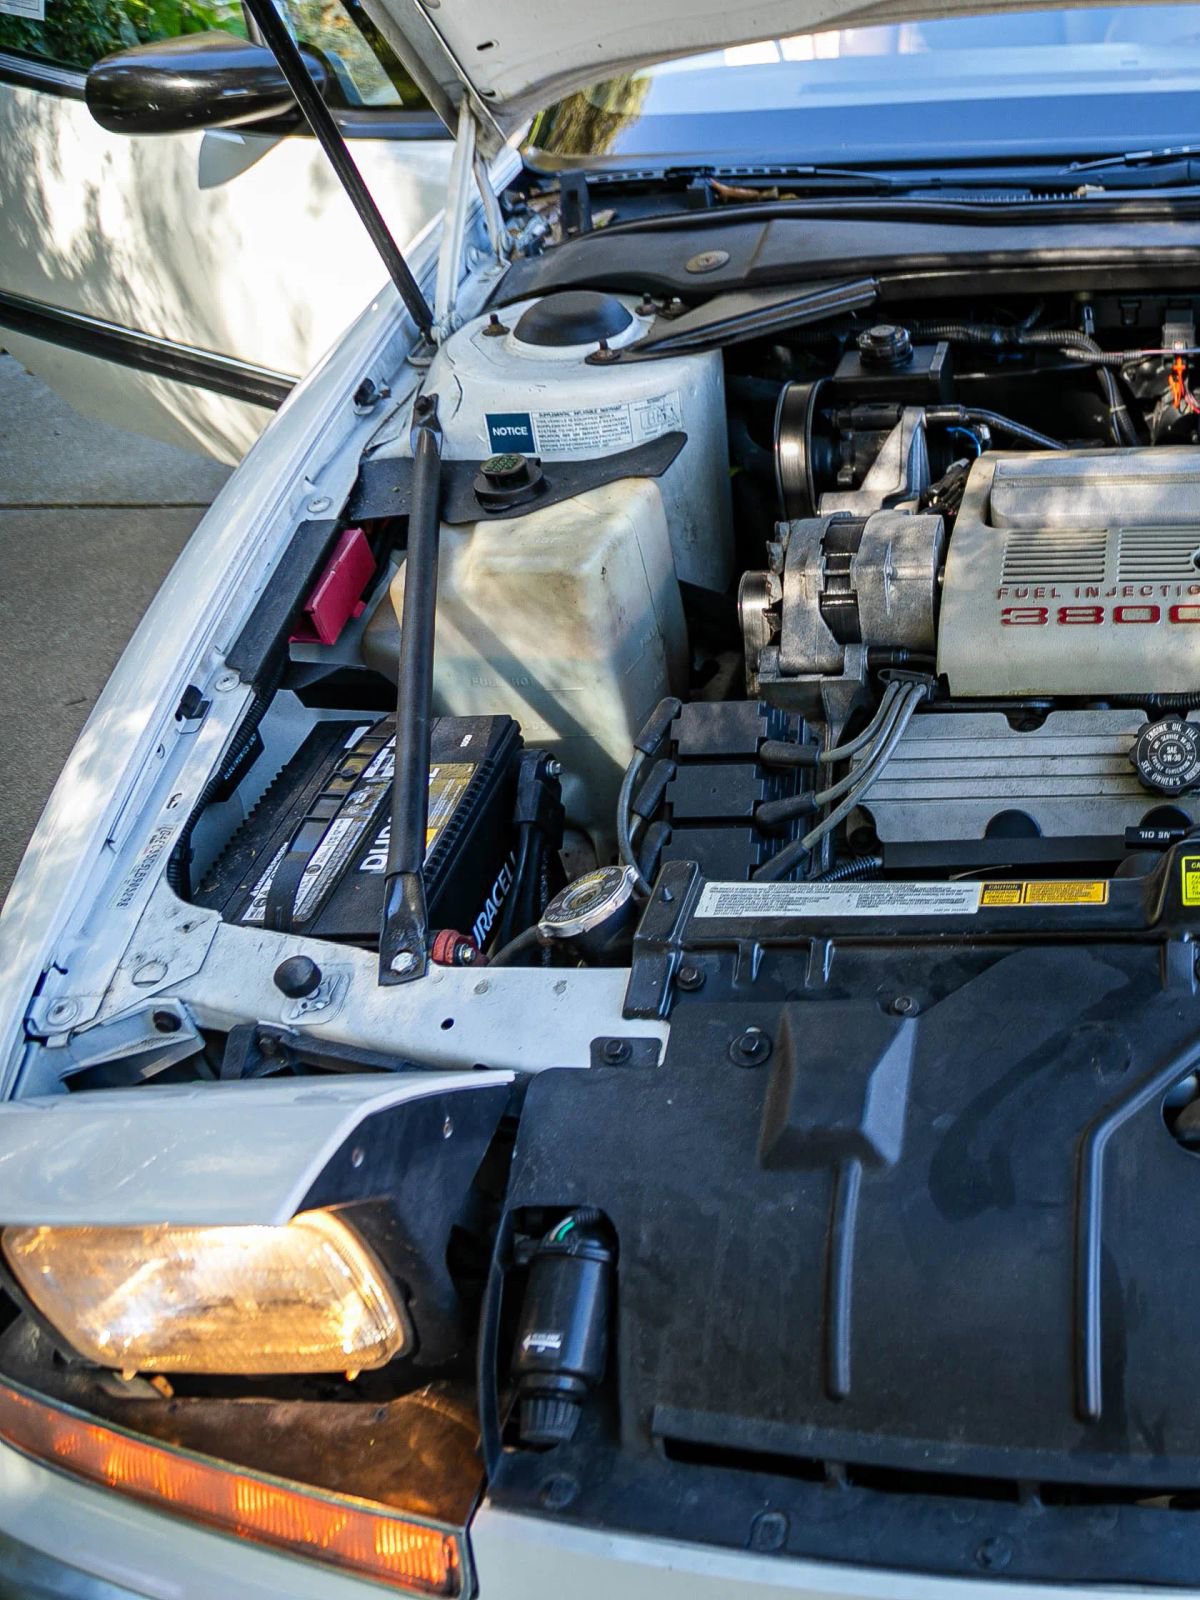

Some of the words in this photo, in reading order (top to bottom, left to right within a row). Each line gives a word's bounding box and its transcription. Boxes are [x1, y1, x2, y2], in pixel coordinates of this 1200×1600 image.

[493, 426, 528, 437] NOTICE
[998, 587, 1061, 599] FUEL
[1146, 723, 1168, 742] ENGINE
[1171, 723, 1182, 732] OIL
[1185, 727, 1198, 741] FILL
[1141, 760, 1152, 773] SEE
[1151, 773, 1181, 786] OWNER'S
[1139, 831, 1155, 839] OIL
